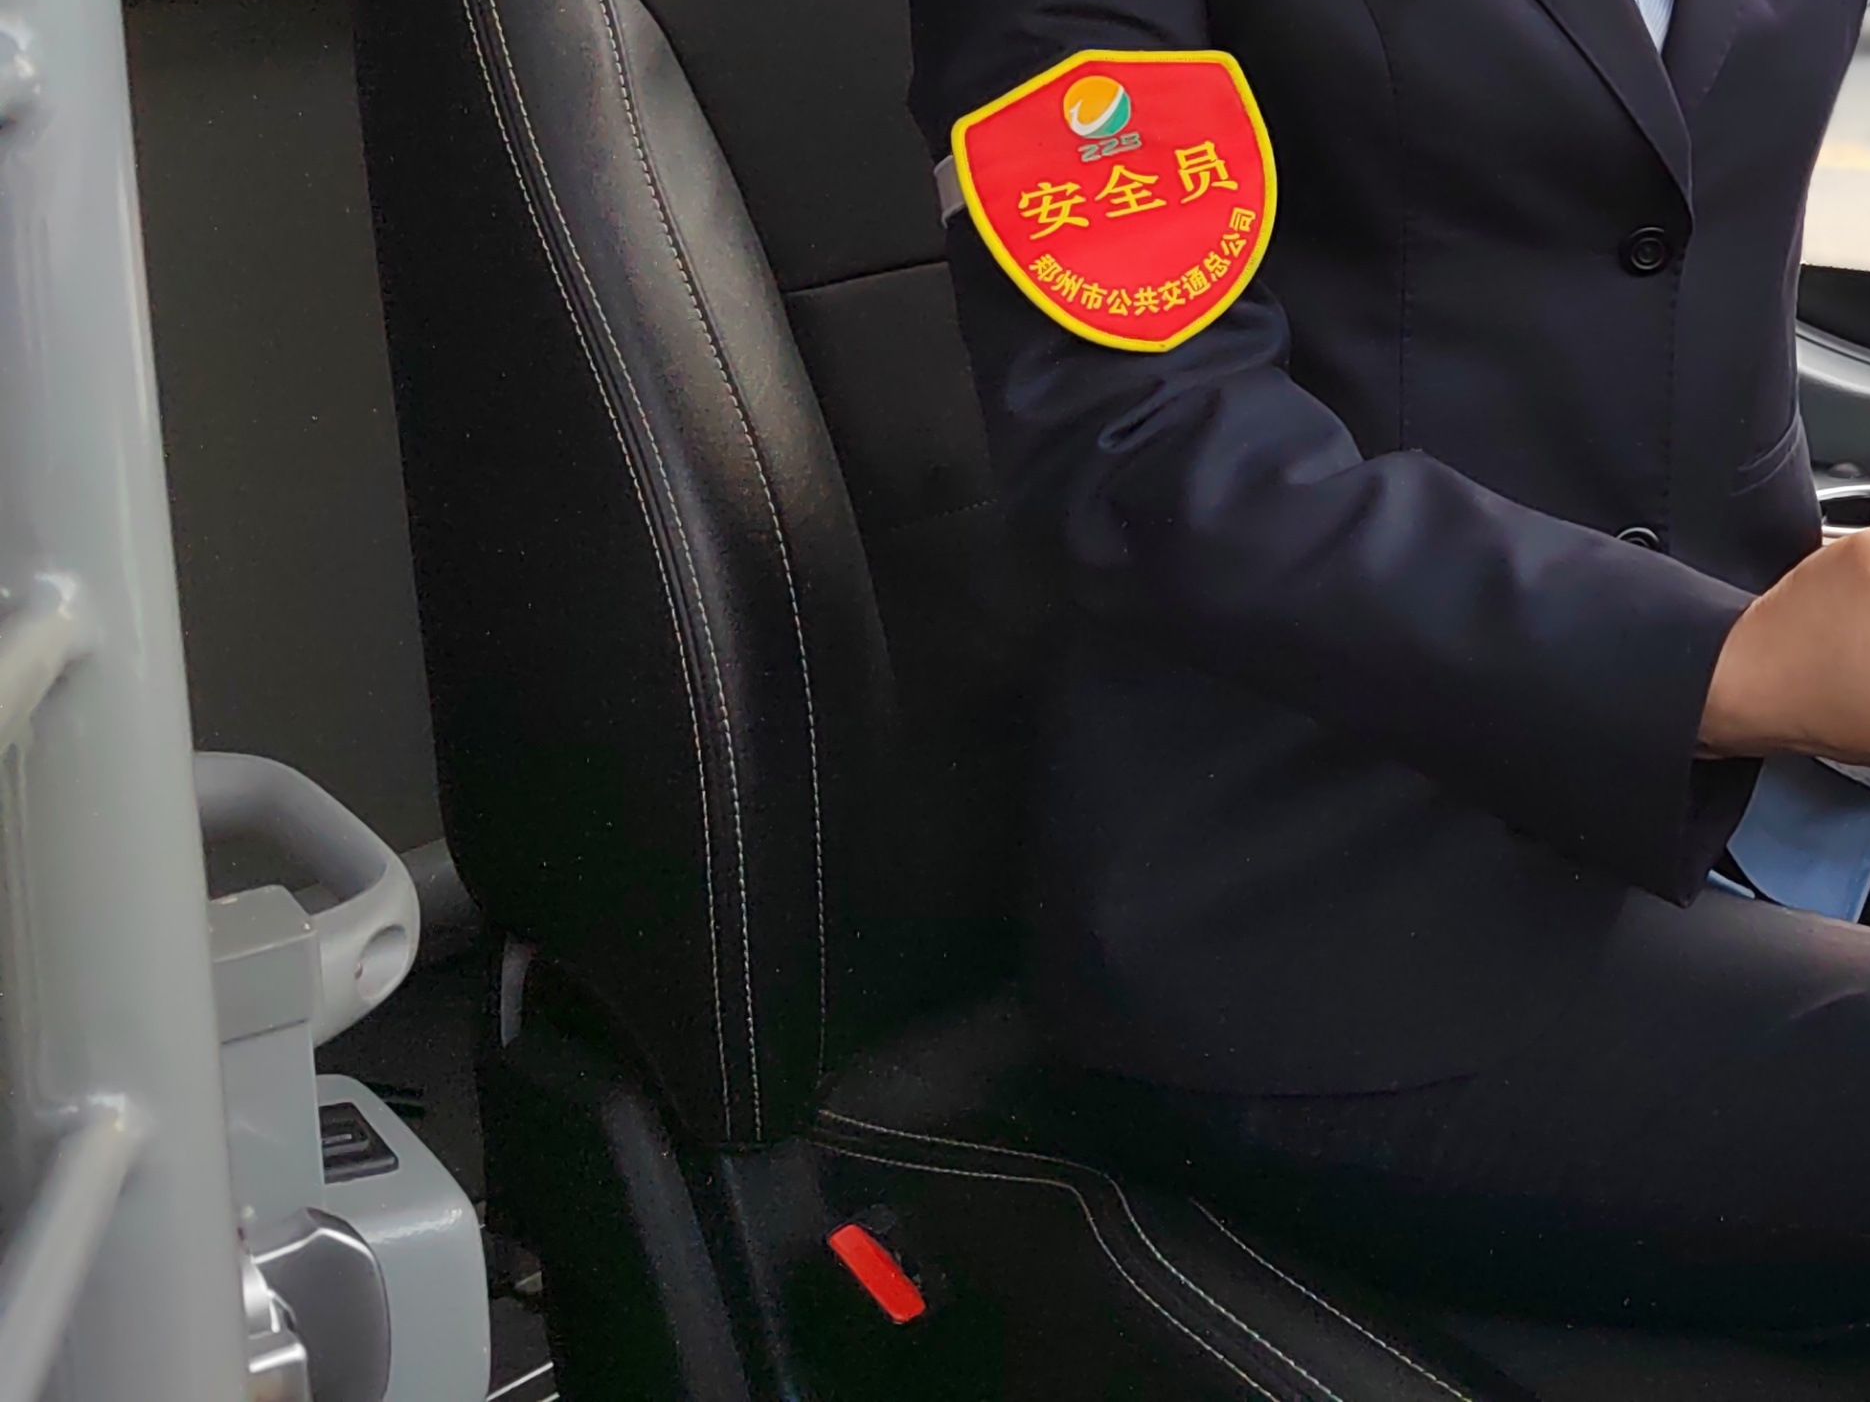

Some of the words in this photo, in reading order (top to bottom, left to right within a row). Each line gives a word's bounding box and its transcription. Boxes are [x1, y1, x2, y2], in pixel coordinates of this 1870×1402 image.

[1018, 141, 1238, 240] 安全员
[1029, 207, 1256, 316] 郑州市公共交通总公司
